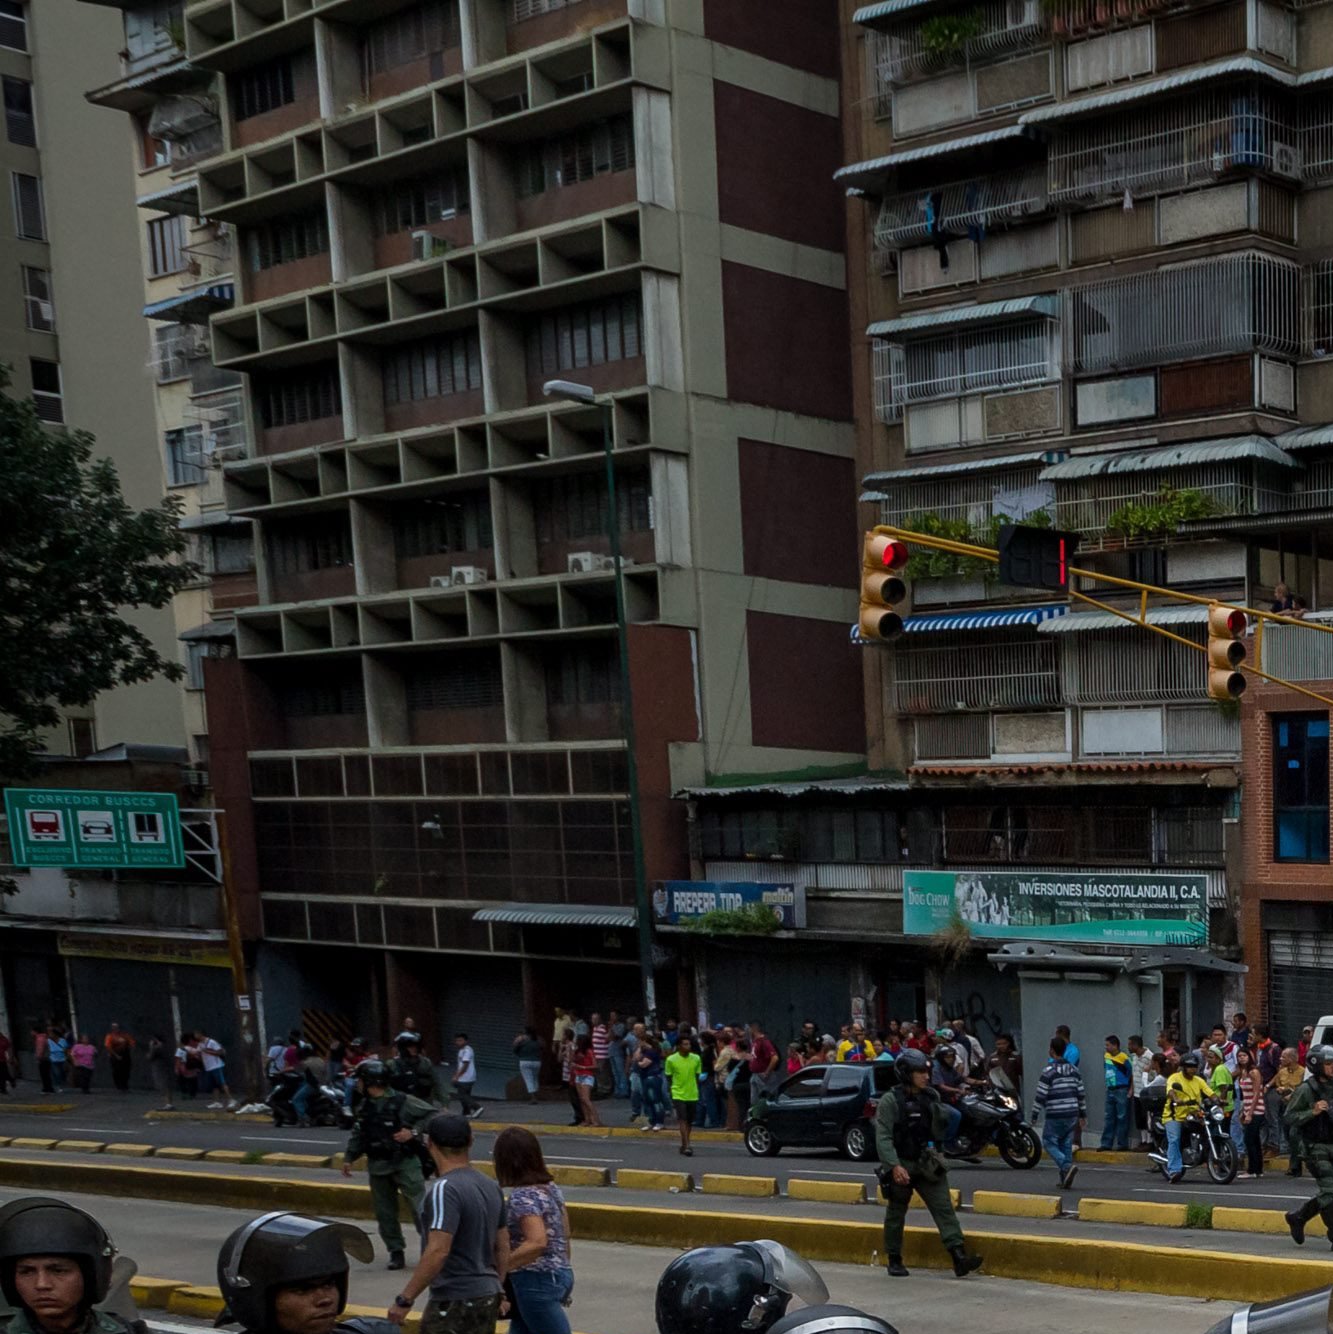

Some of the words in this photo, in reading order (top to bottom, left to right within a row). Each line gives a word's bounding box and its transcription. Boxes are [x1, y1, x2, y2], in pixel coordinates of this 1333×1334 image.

[28, 793, 100, 806] CORREDOR
[105, 796, 157, 807] BUSCCS
[907, 885, 926, 905] DOG
[1018, 881, 1083, 897] INVERSIONES
[1083, 883, 1169, 899] MASCOTALANDIA
[1180, 885, 1201, 899] C.A.
[673, 891, 717, 913] AREPERA
